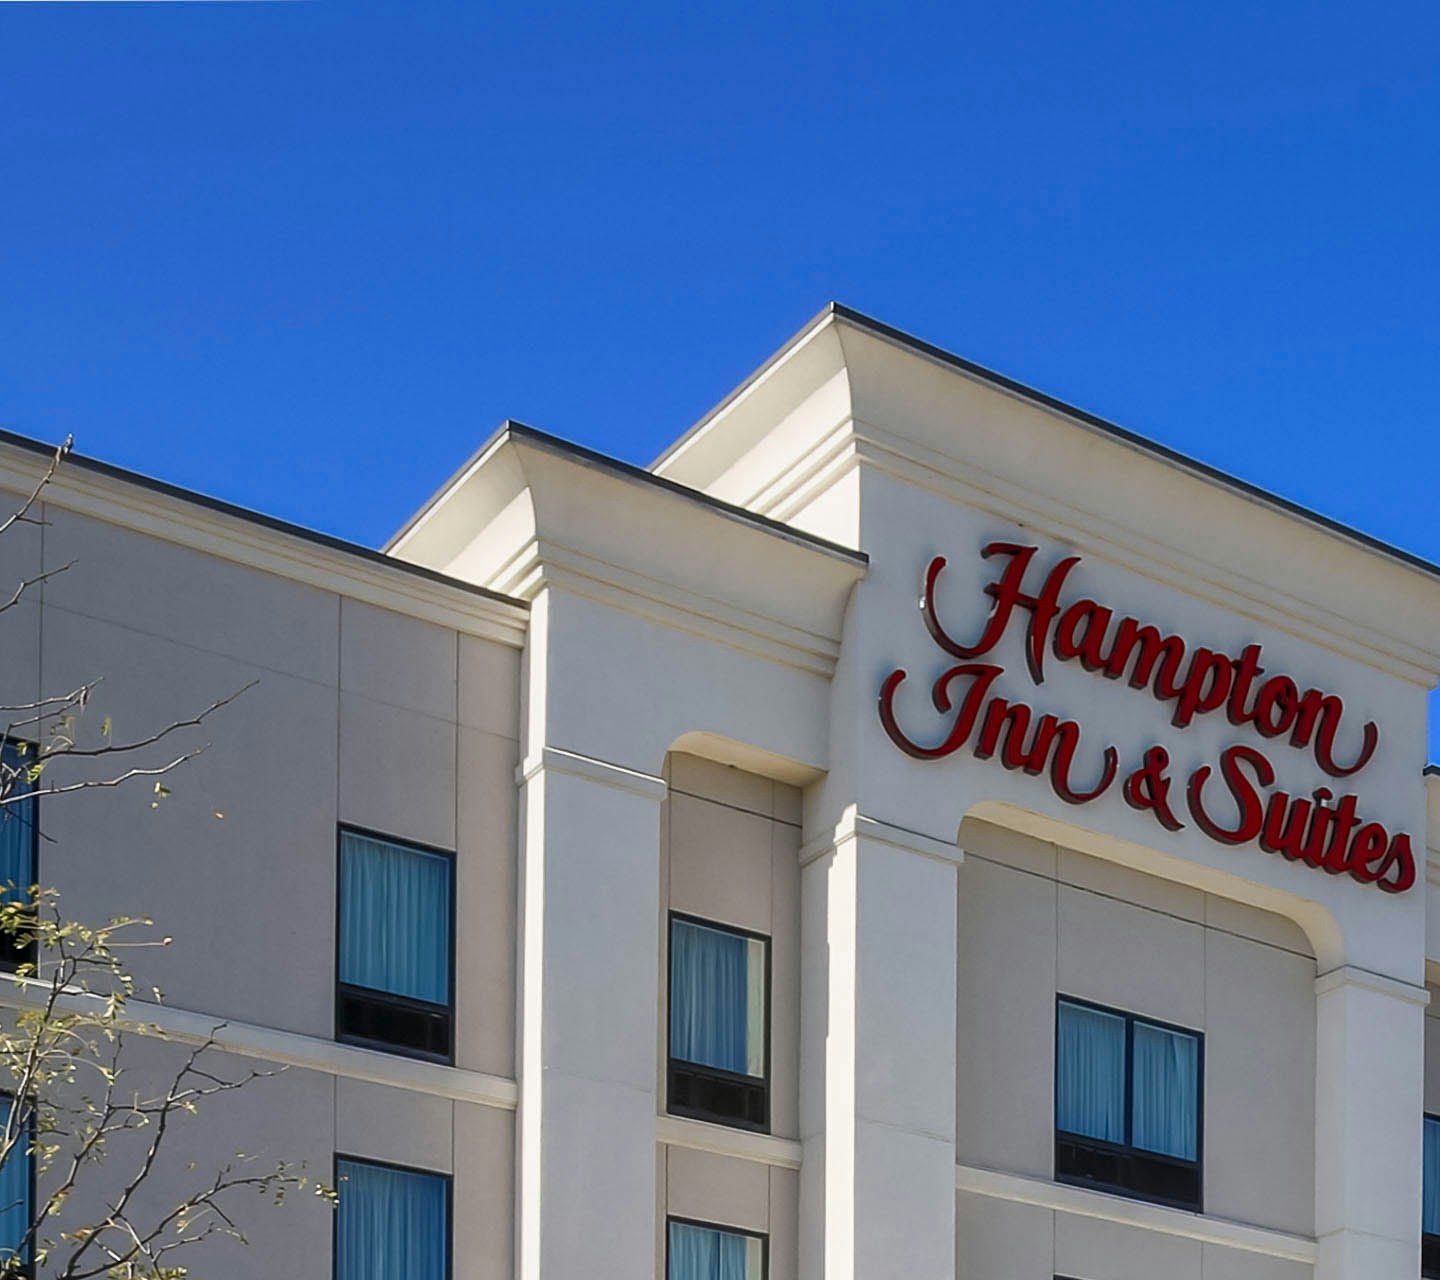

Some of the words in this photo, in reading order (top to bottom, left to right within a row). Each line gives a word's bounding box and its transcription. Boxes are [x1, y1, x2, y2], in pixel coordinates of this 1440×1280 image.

[924, 541, 1378, 778] Hampton
[879, 663, 1118, 804] Inn
[1123, 745, 1184, 831] &
[1187, 745, 1416, 894] Suites
